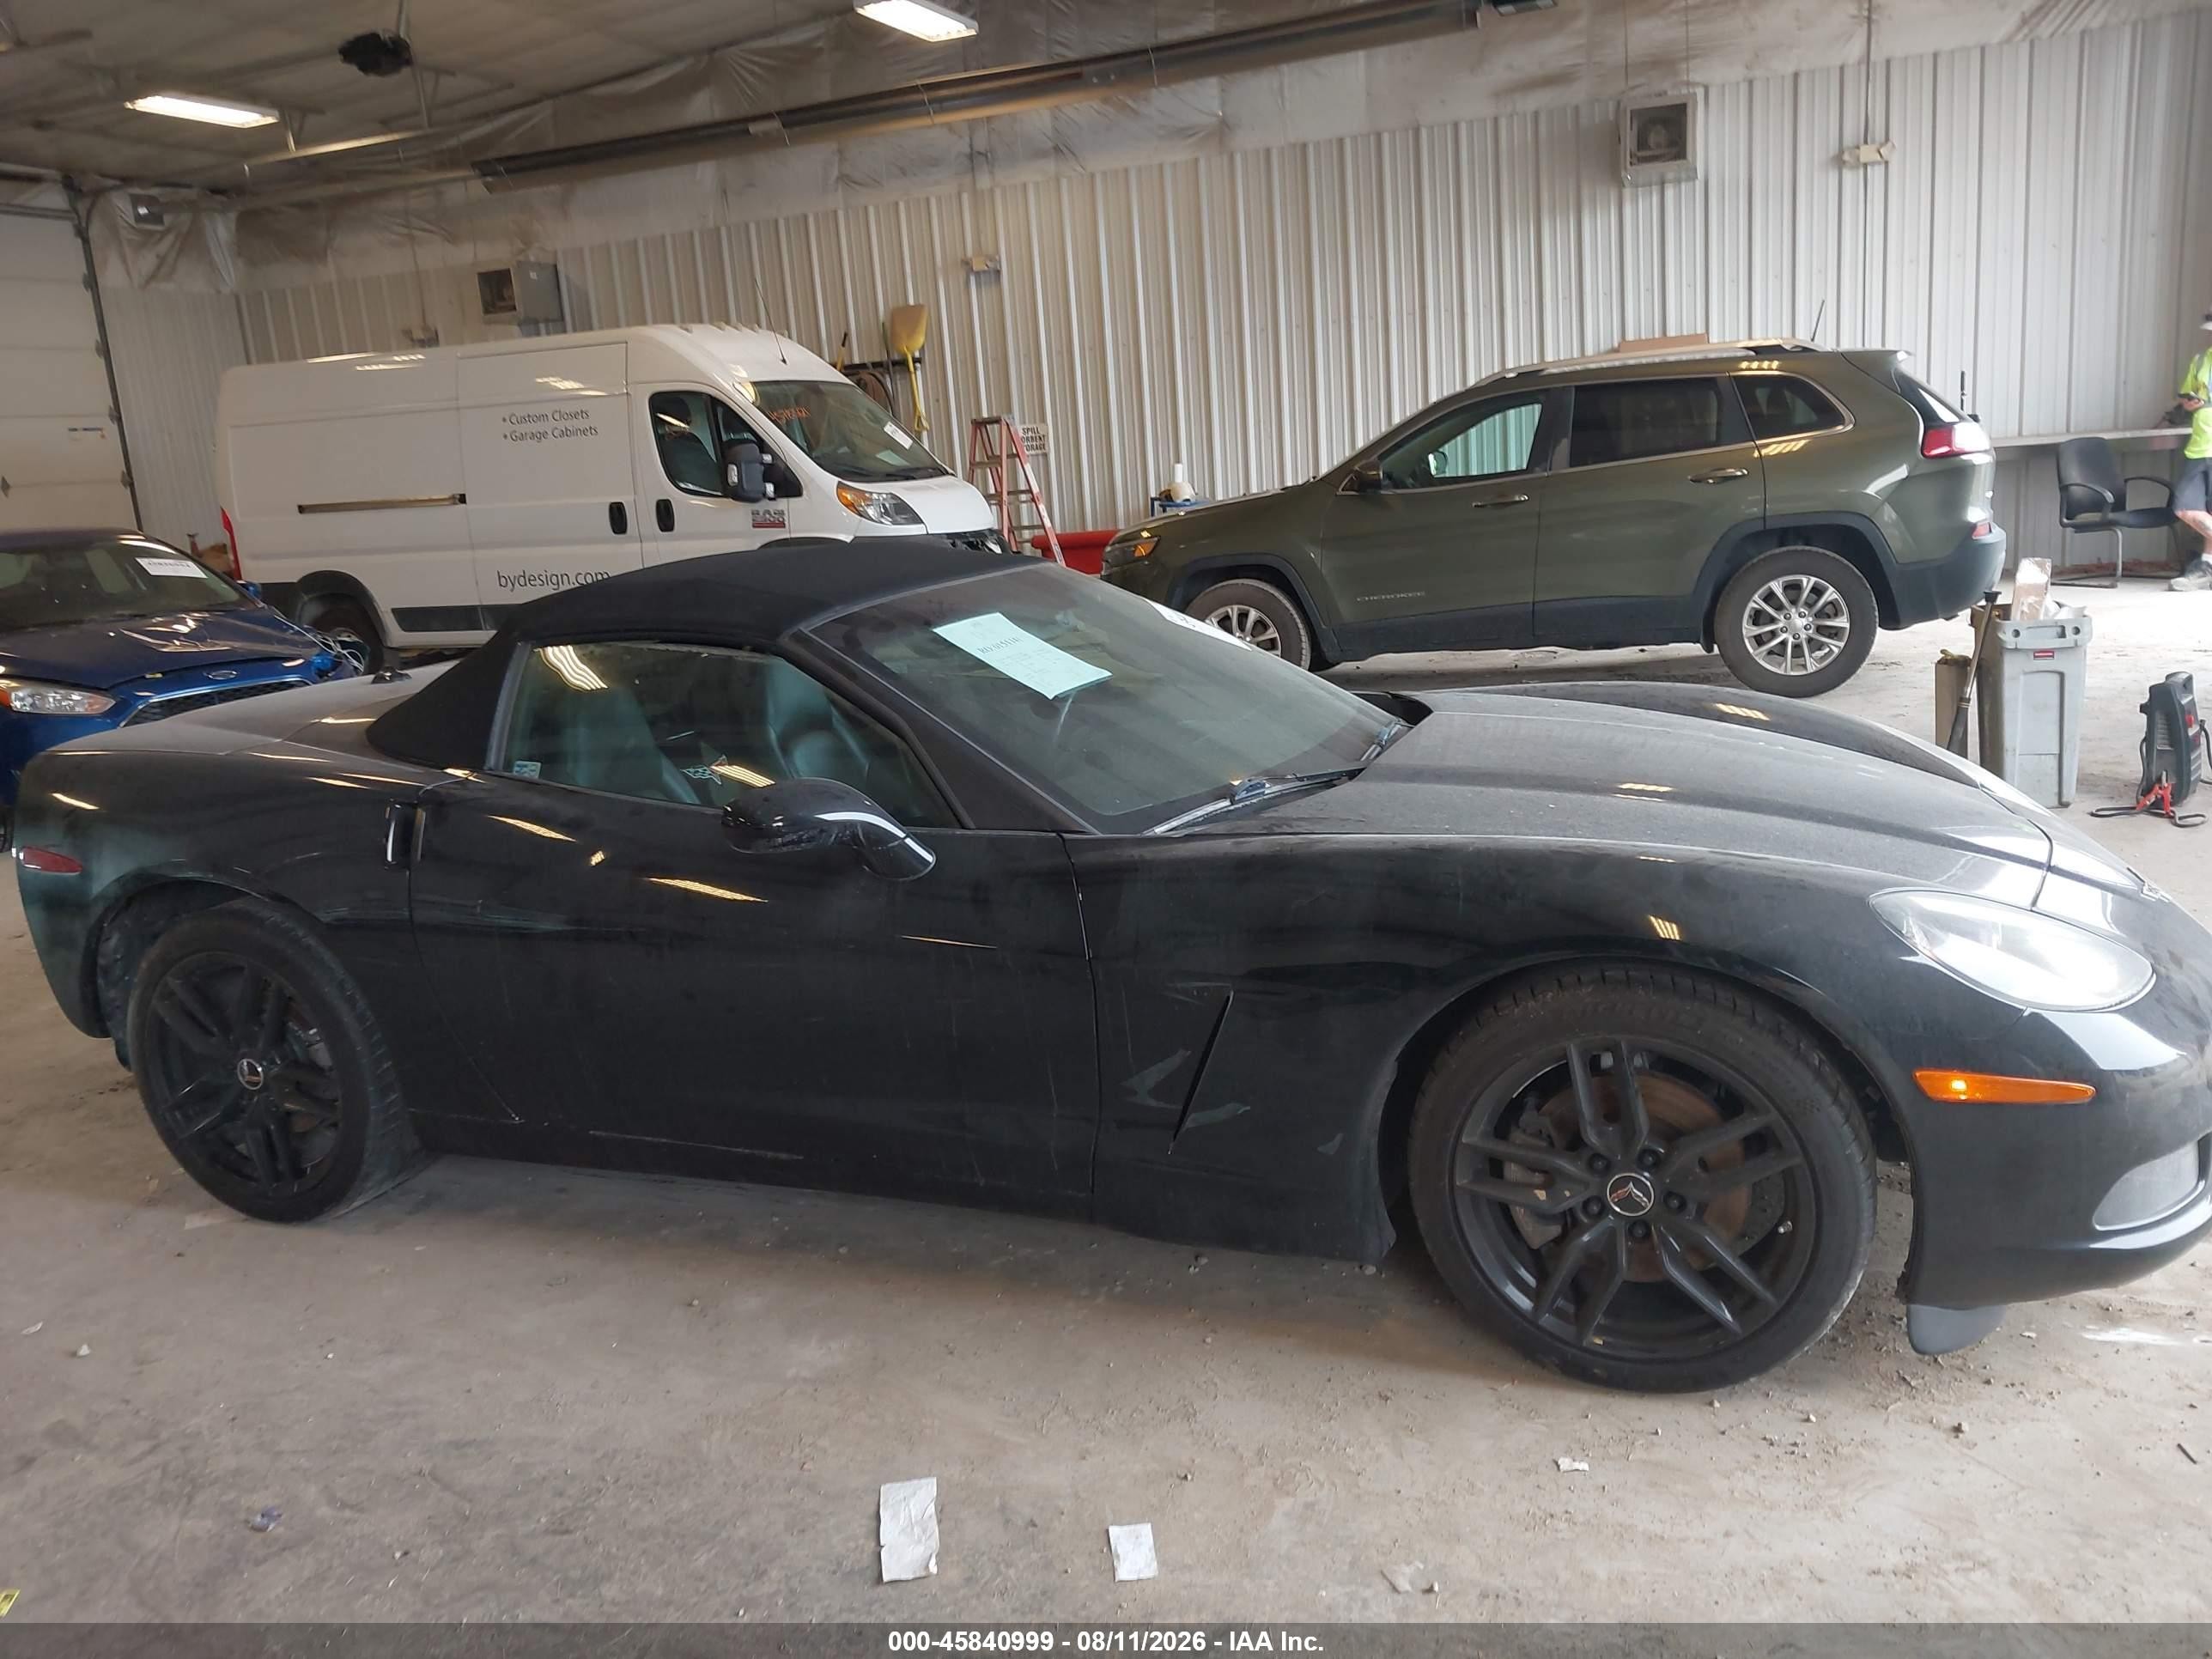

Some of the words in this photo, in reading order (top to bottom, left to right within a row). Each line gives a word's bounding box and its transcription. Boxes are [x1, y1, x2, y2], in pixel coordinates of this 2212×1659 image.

[508, 413, 549, 425] Custom
[551, 410, 590, 422] Closets
[509, 430, 549, 442] Garage
[551, 426, 599, 439] Cabinets
[1022, 427, 1040, 435] SPILL
[497, 569, 611, 592] bydesign.com
